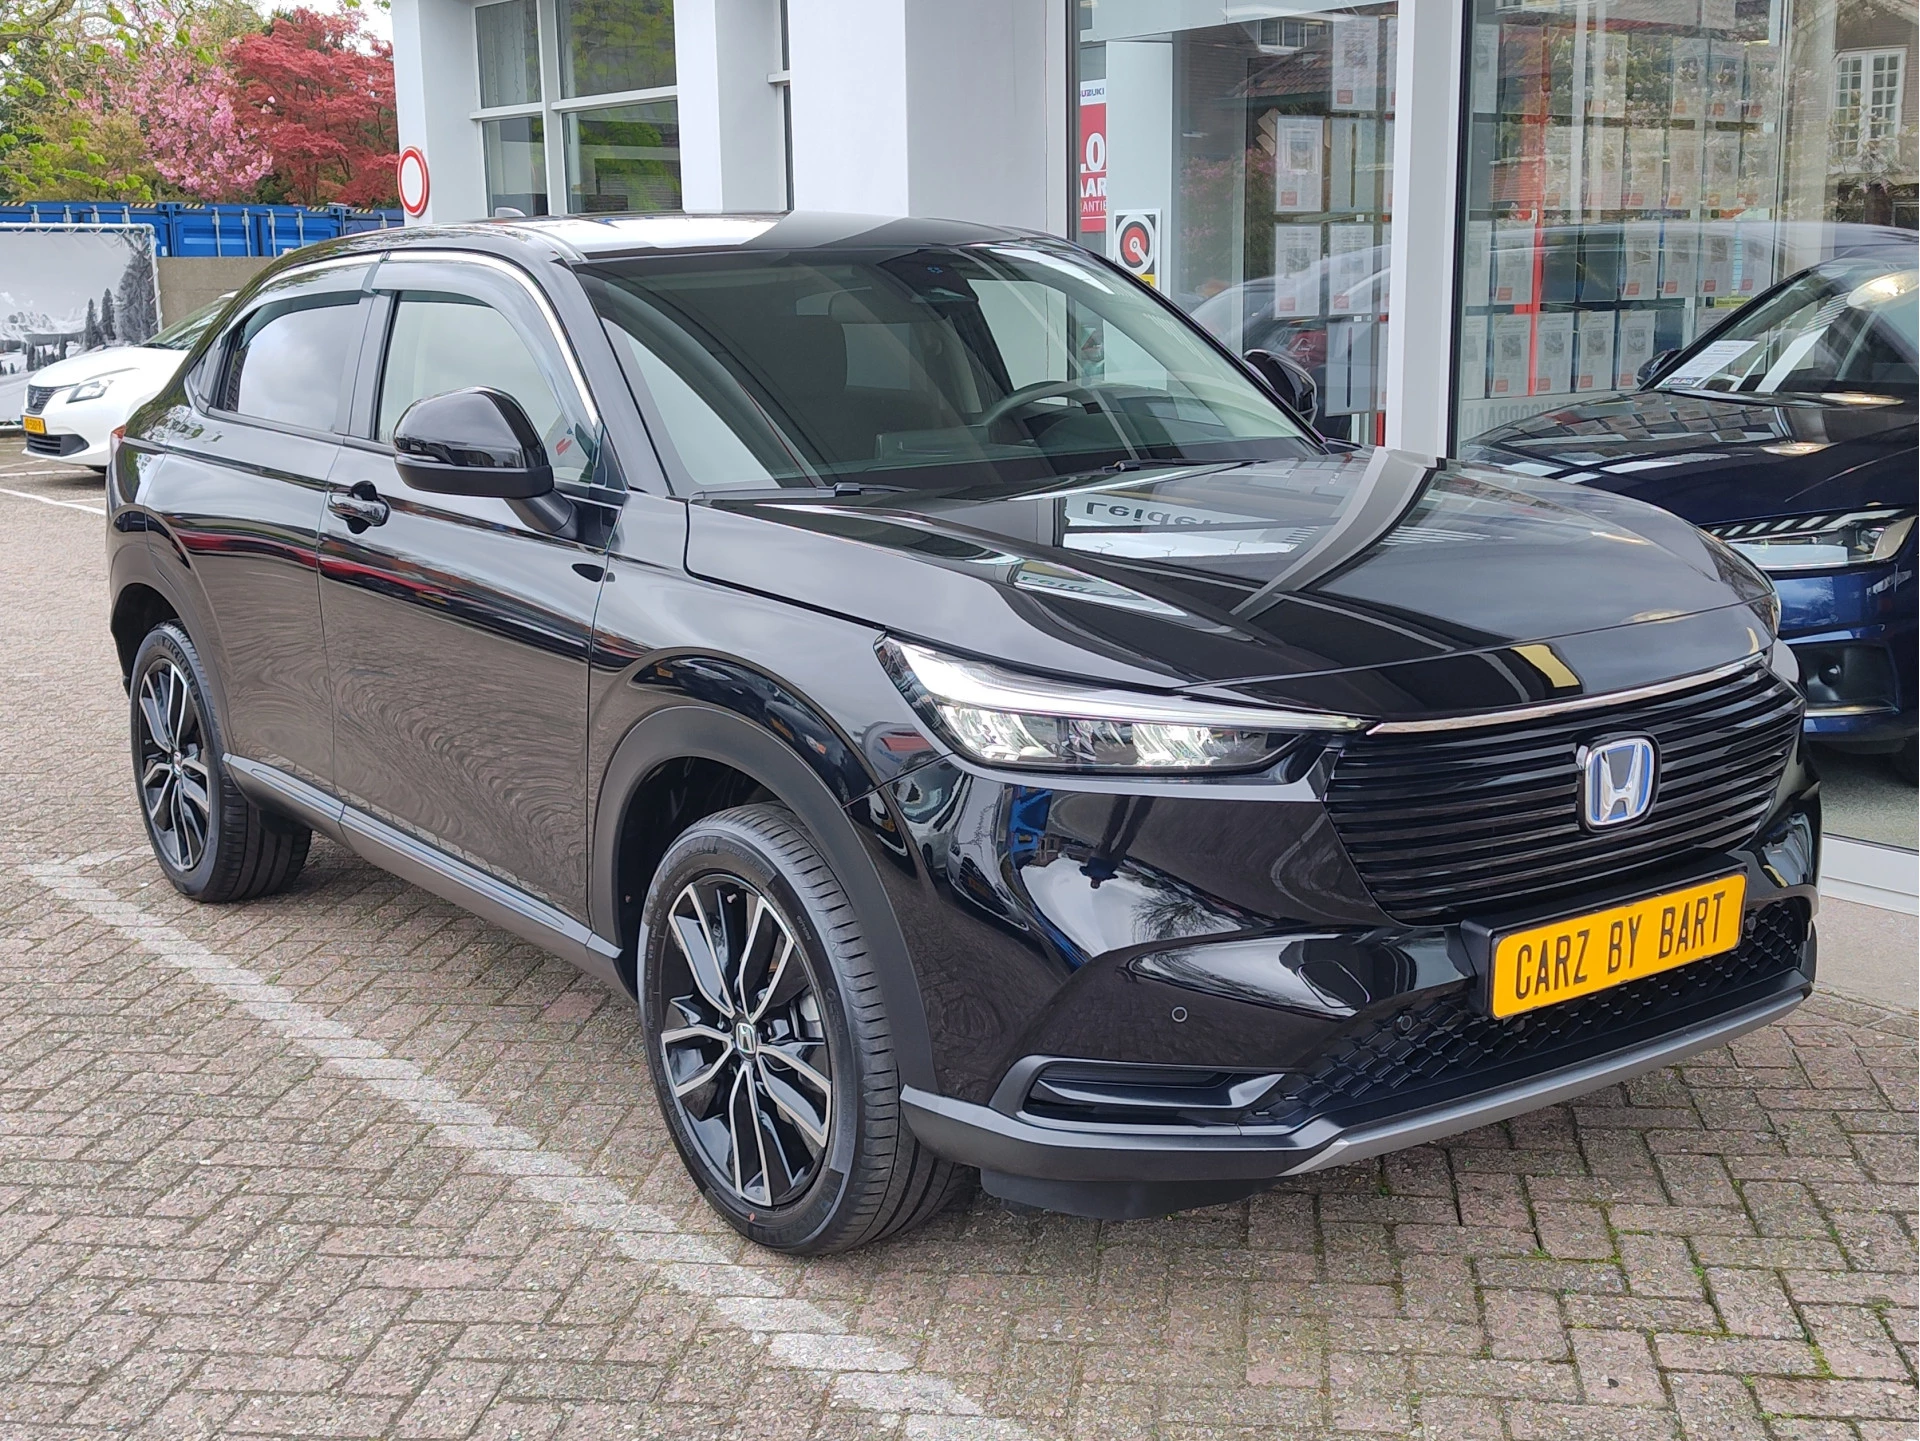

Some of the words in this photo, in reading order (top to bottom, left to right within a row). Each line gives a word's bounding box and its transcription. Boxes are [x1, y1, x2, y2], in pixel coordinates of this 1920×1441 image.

[1080, 87, 1105, 97] UZUKI
[1515, 930, 1591, 1000] CARZ
[1607, 914, 1643, 975] BY
[1658, 891, 1726, 960] BART
